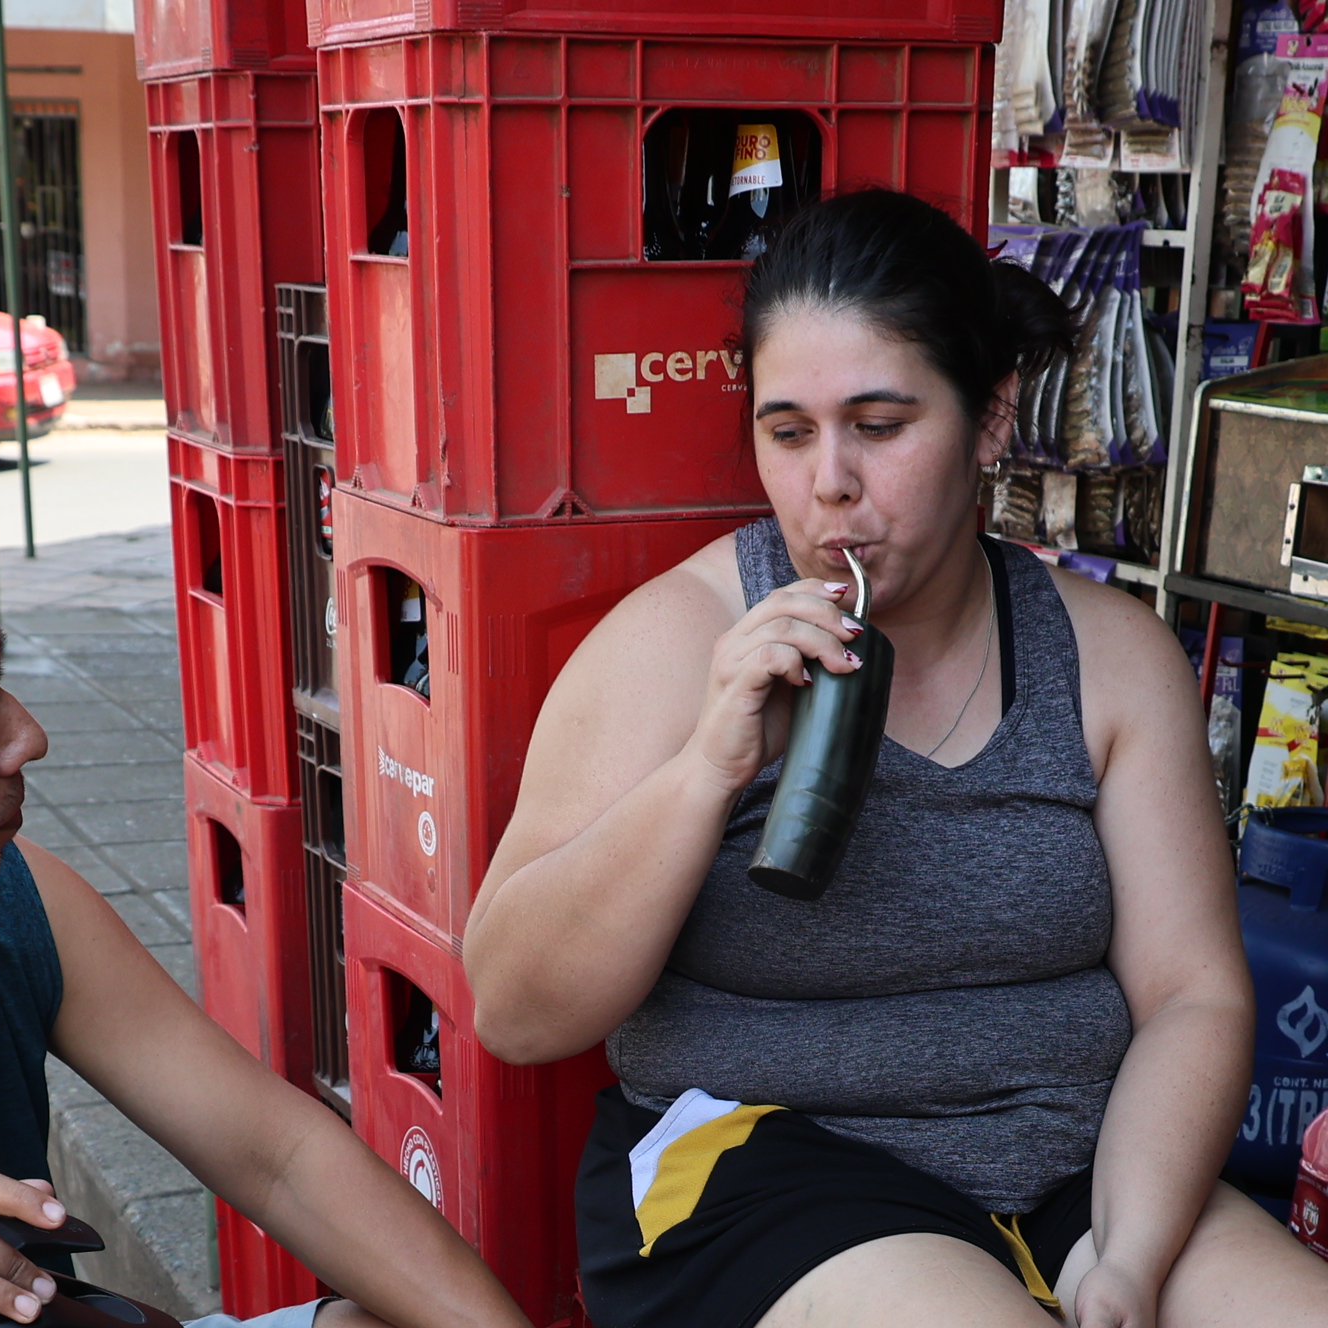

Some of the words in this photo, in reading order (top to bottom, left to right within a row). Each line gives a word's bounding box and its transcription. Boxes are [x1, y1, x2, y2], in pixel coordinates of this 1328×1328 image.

[731, 176, 765, 186] ETORNABLE
[1274, 1077, 1309, 1088] CONT.
[402, 1138, 413, 1175] HECHO
[413, 1134, 424, 1147] CON
